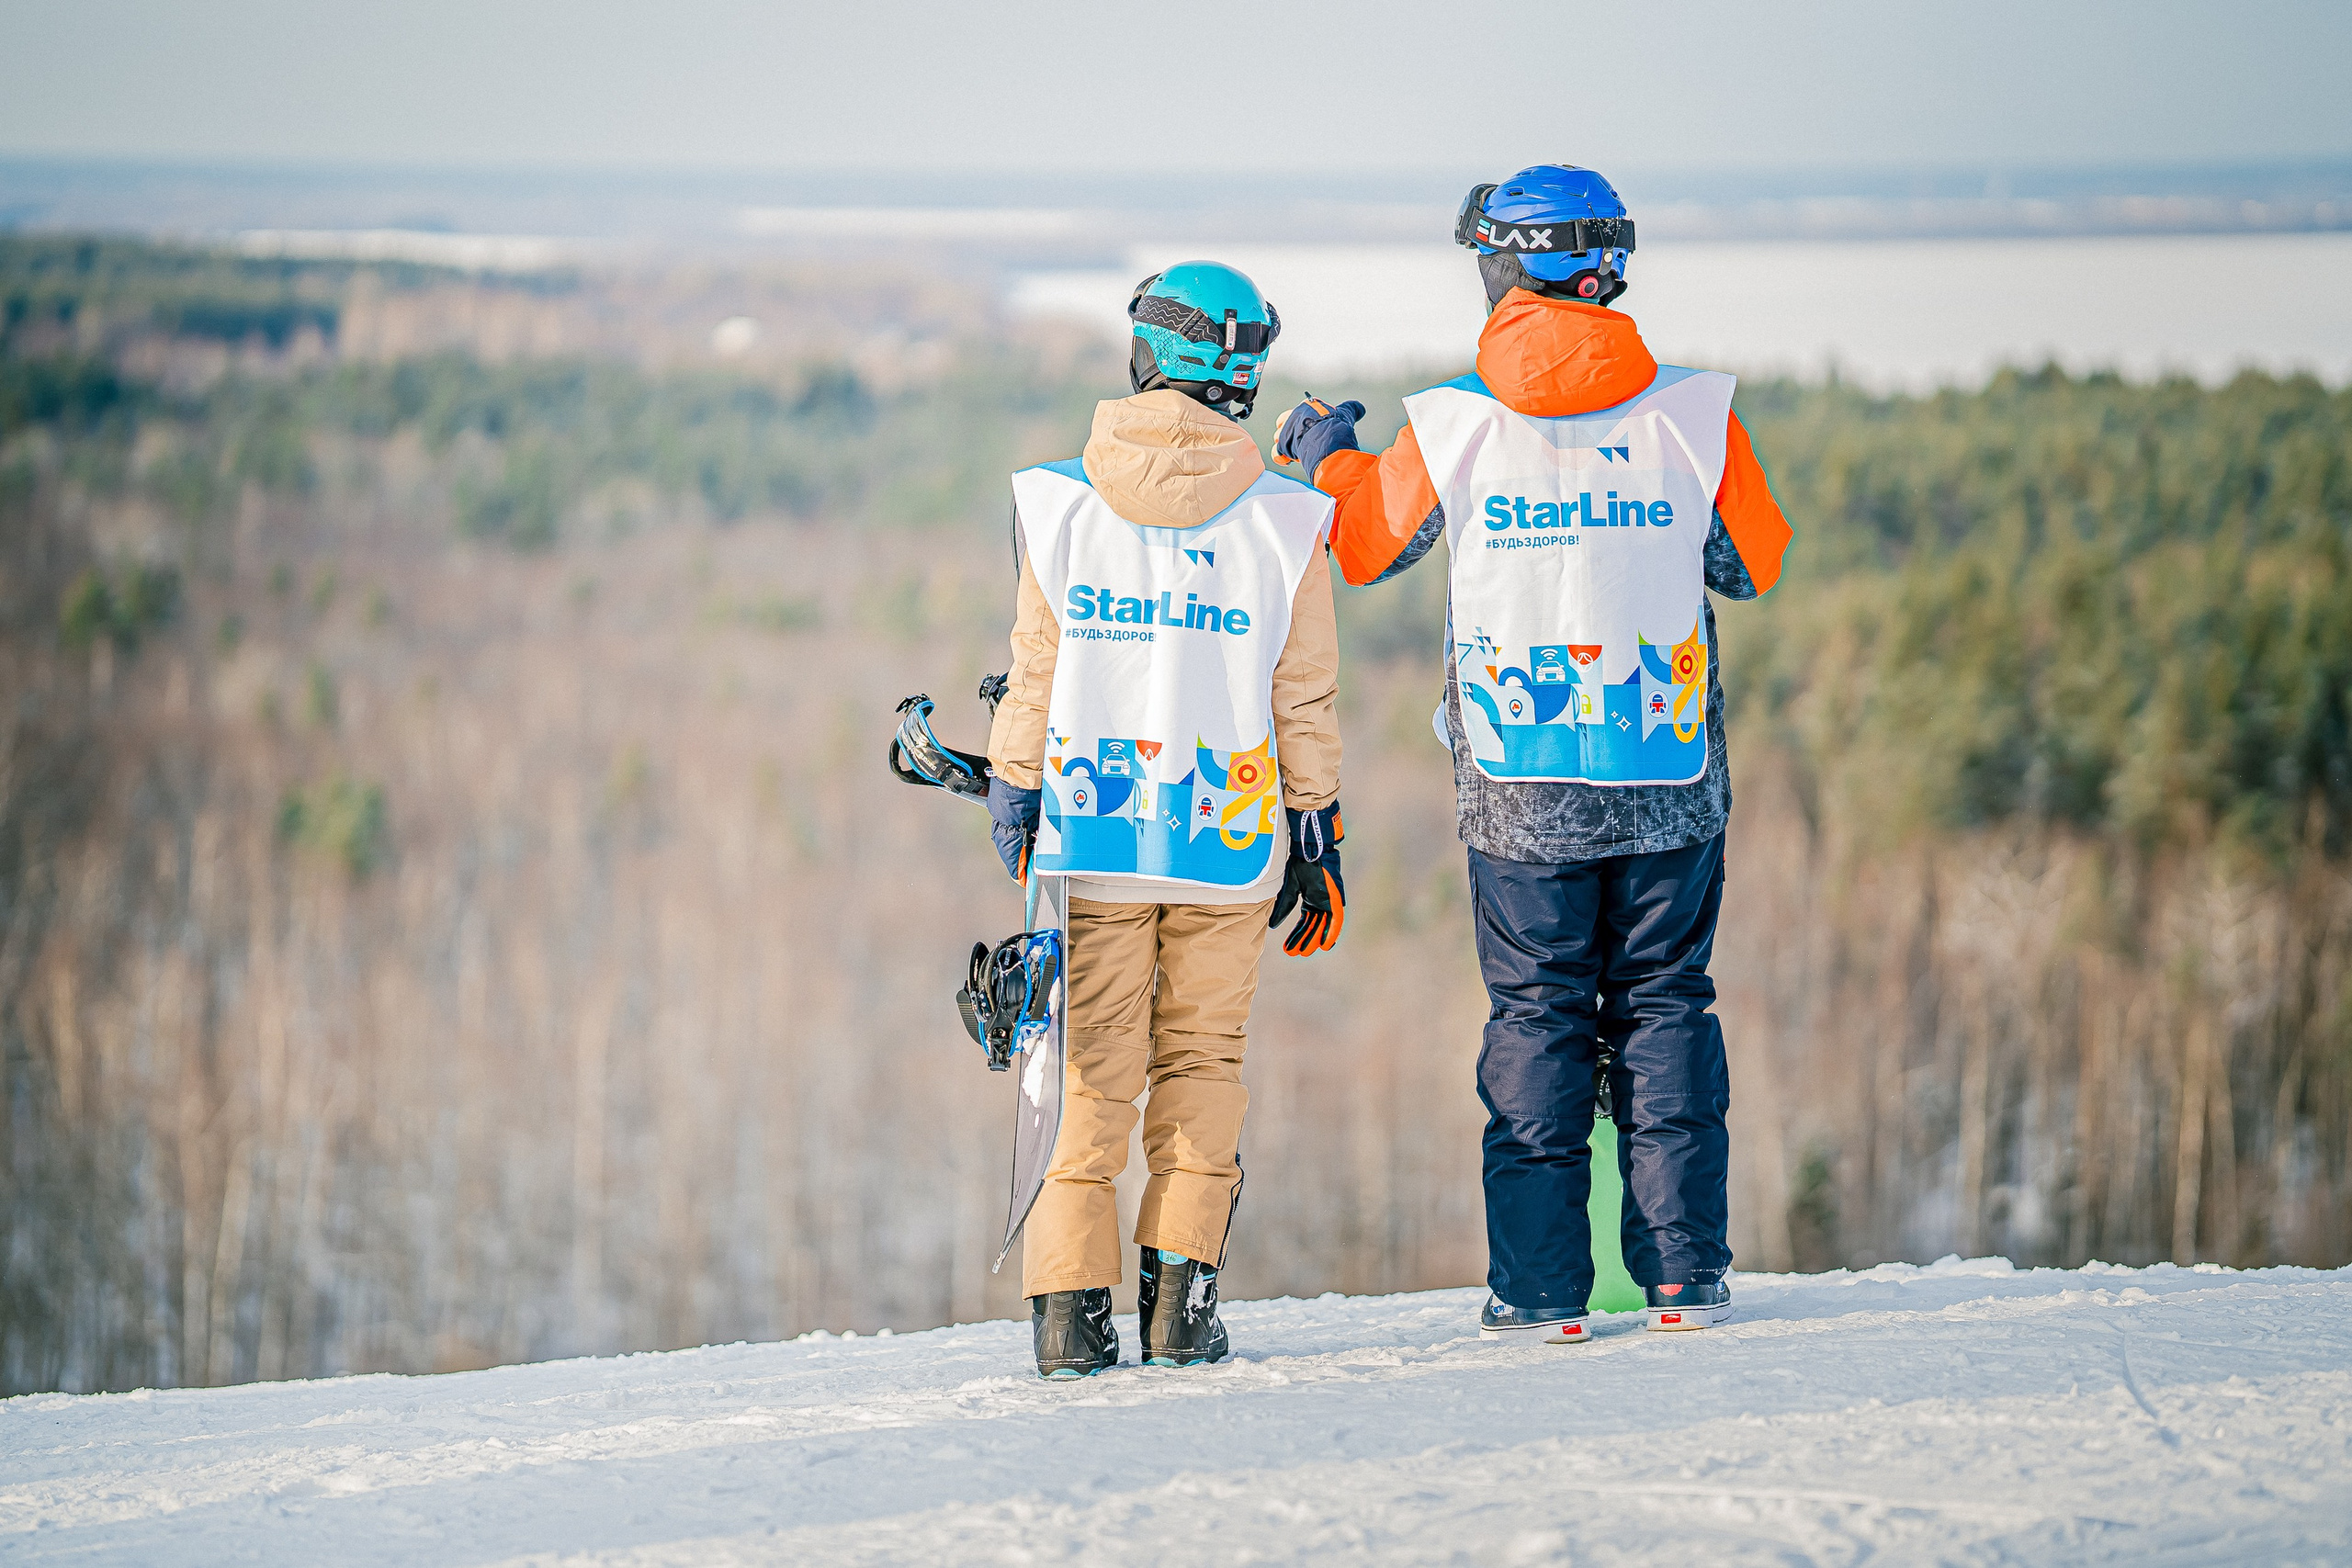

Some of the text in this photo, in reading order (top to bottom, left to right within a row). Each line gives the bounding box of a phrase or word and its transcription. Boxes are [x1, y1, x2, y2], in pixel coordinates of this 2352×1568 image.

[1484, 491, 1674, 531] StarLine
[1486, 535, 1579, 549] #БУДЬЗДОРОВ!
[1066, 584, 1250, 636] StarLine
